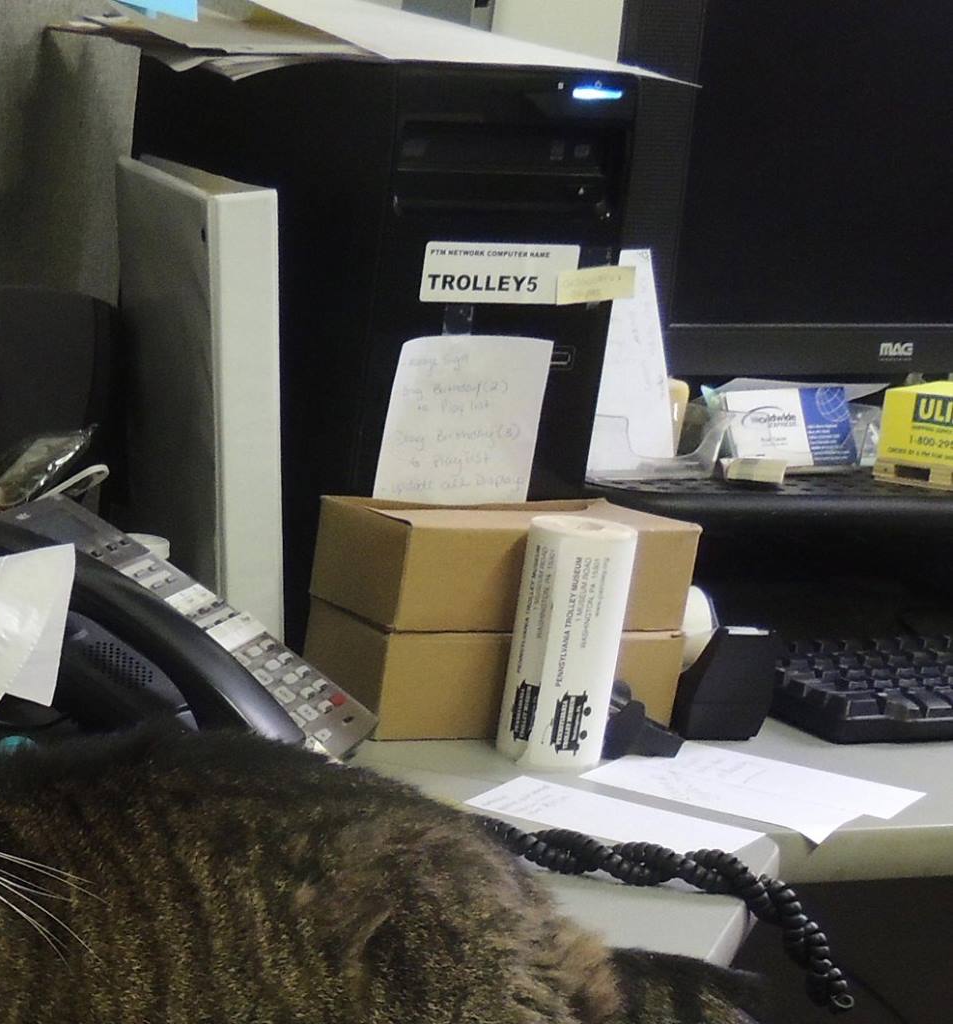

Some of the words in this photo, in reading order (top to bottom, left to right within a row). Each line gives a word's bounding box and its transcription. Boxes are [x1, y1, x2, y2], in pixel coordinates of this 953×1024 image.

[448, 249, 485, 257] NETWORK
[487, 250, 528, 258] COMPUTER
[427, 274, 539, 292] TROLLEY5
[879, 342, 913, 357] MAG
[577, 582, 590, 616] MUSEUM
[584, 557, 593, 581] ROAD
[517, 617, 530, 674] PENNSYLVANIA
[526, 579, 536, 616] TROLLEY
[555, 632, 573, 688] PENNSYLVANIA
[565, 591, 577, 631] TROLLEY
[571, 557, 582, 591] MUSEUM
